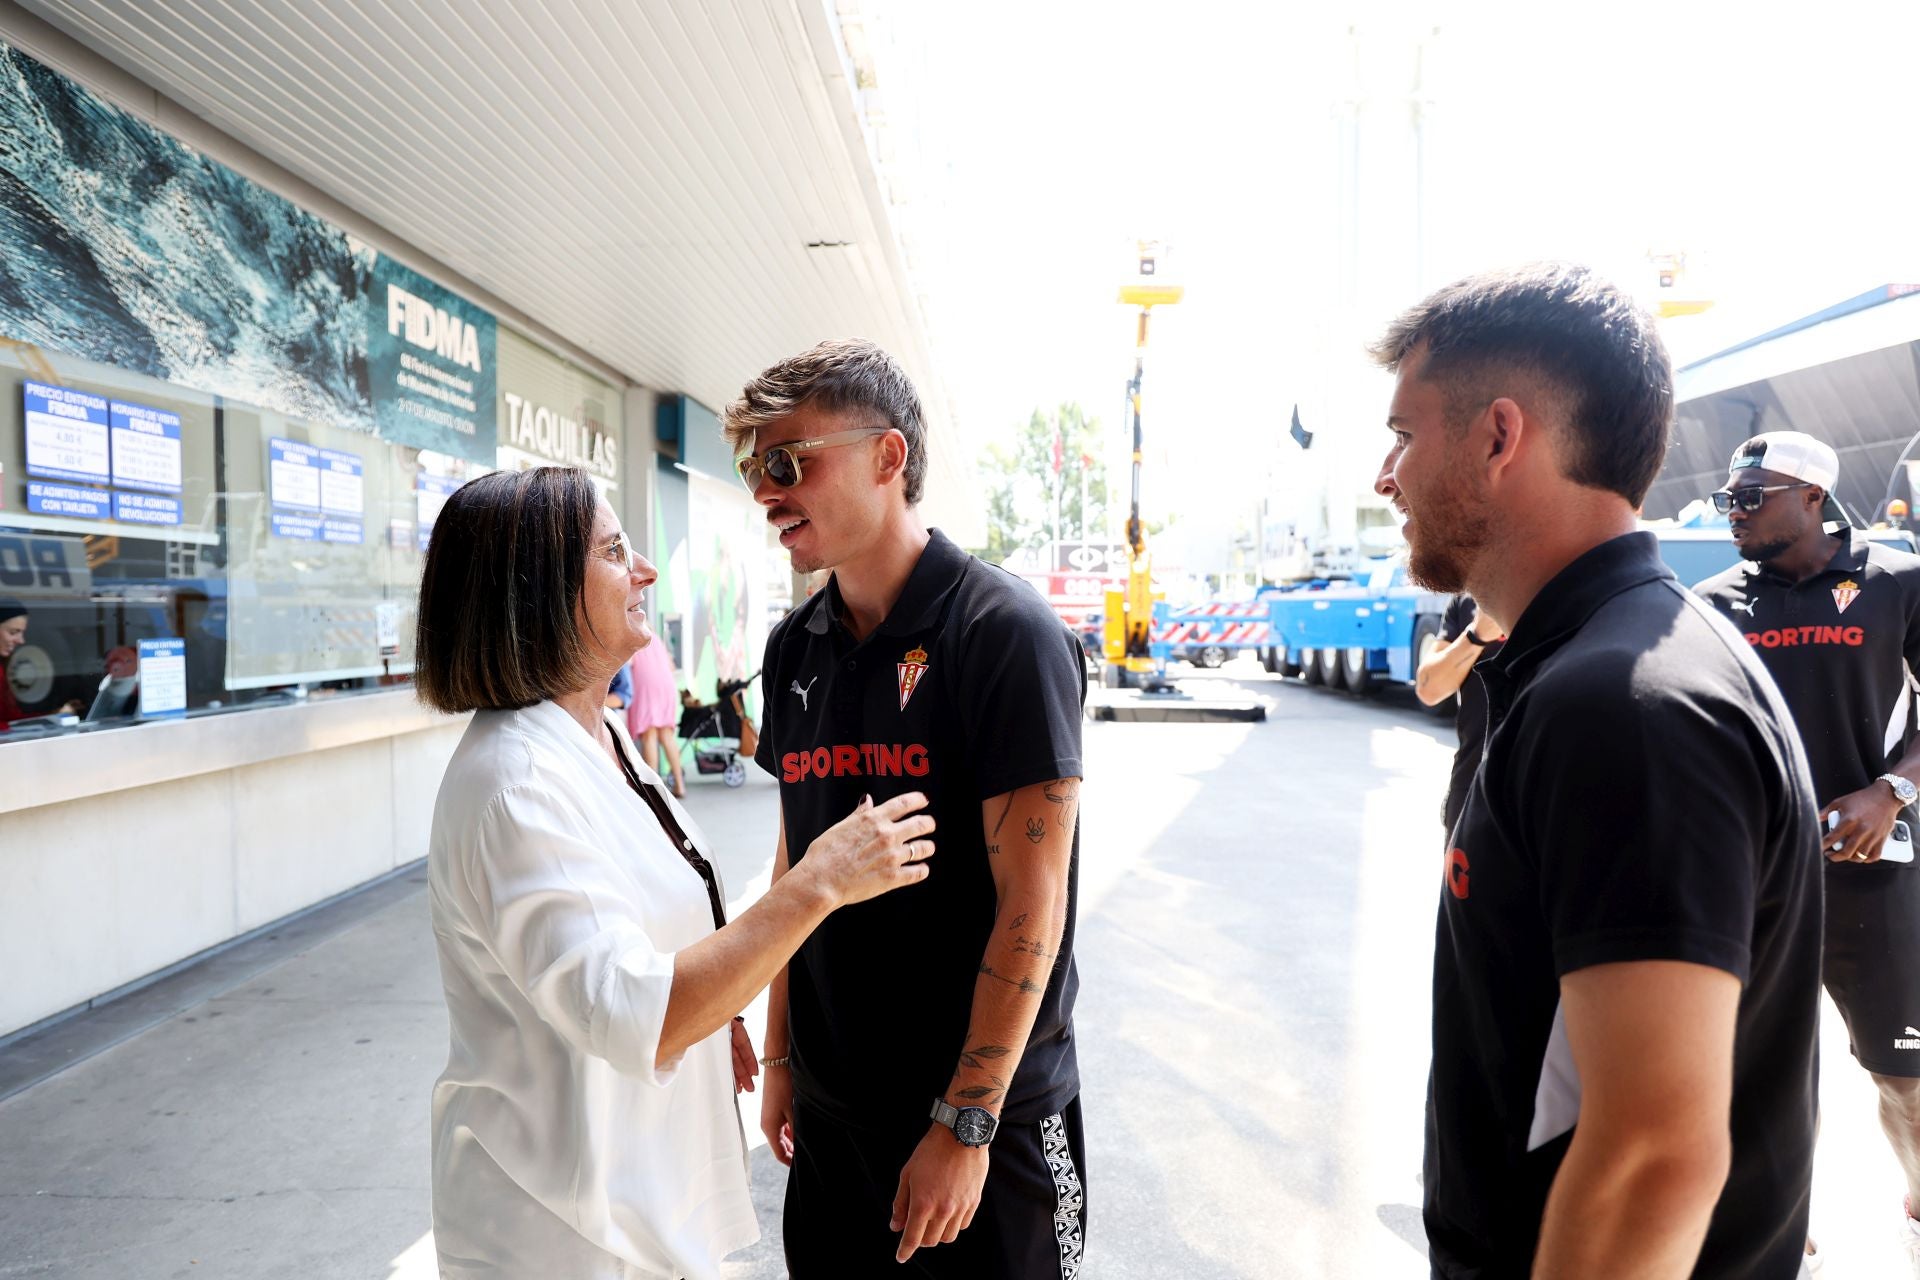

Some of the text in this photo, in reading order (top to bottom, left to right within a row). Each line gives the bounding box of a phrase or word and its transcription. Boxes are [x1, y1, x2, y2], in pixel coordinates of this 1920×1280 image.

[388, 283, 481, 372] FIDMA
[26, 382, 108, 411] PRECIO ENTRADA
[505, 391, 617, 478] TAQUILLAS
[29, 484, 43, 496] SE
[43, 485, 80, 501] ADMITEN
[41, 499, 98, 515] CON TARJETA
[118, 506, 178, 524] DEVOLUCIONES
[1744, 625, 1864, 648] PORTING
[782, 743, 930, 783] SPORTING
